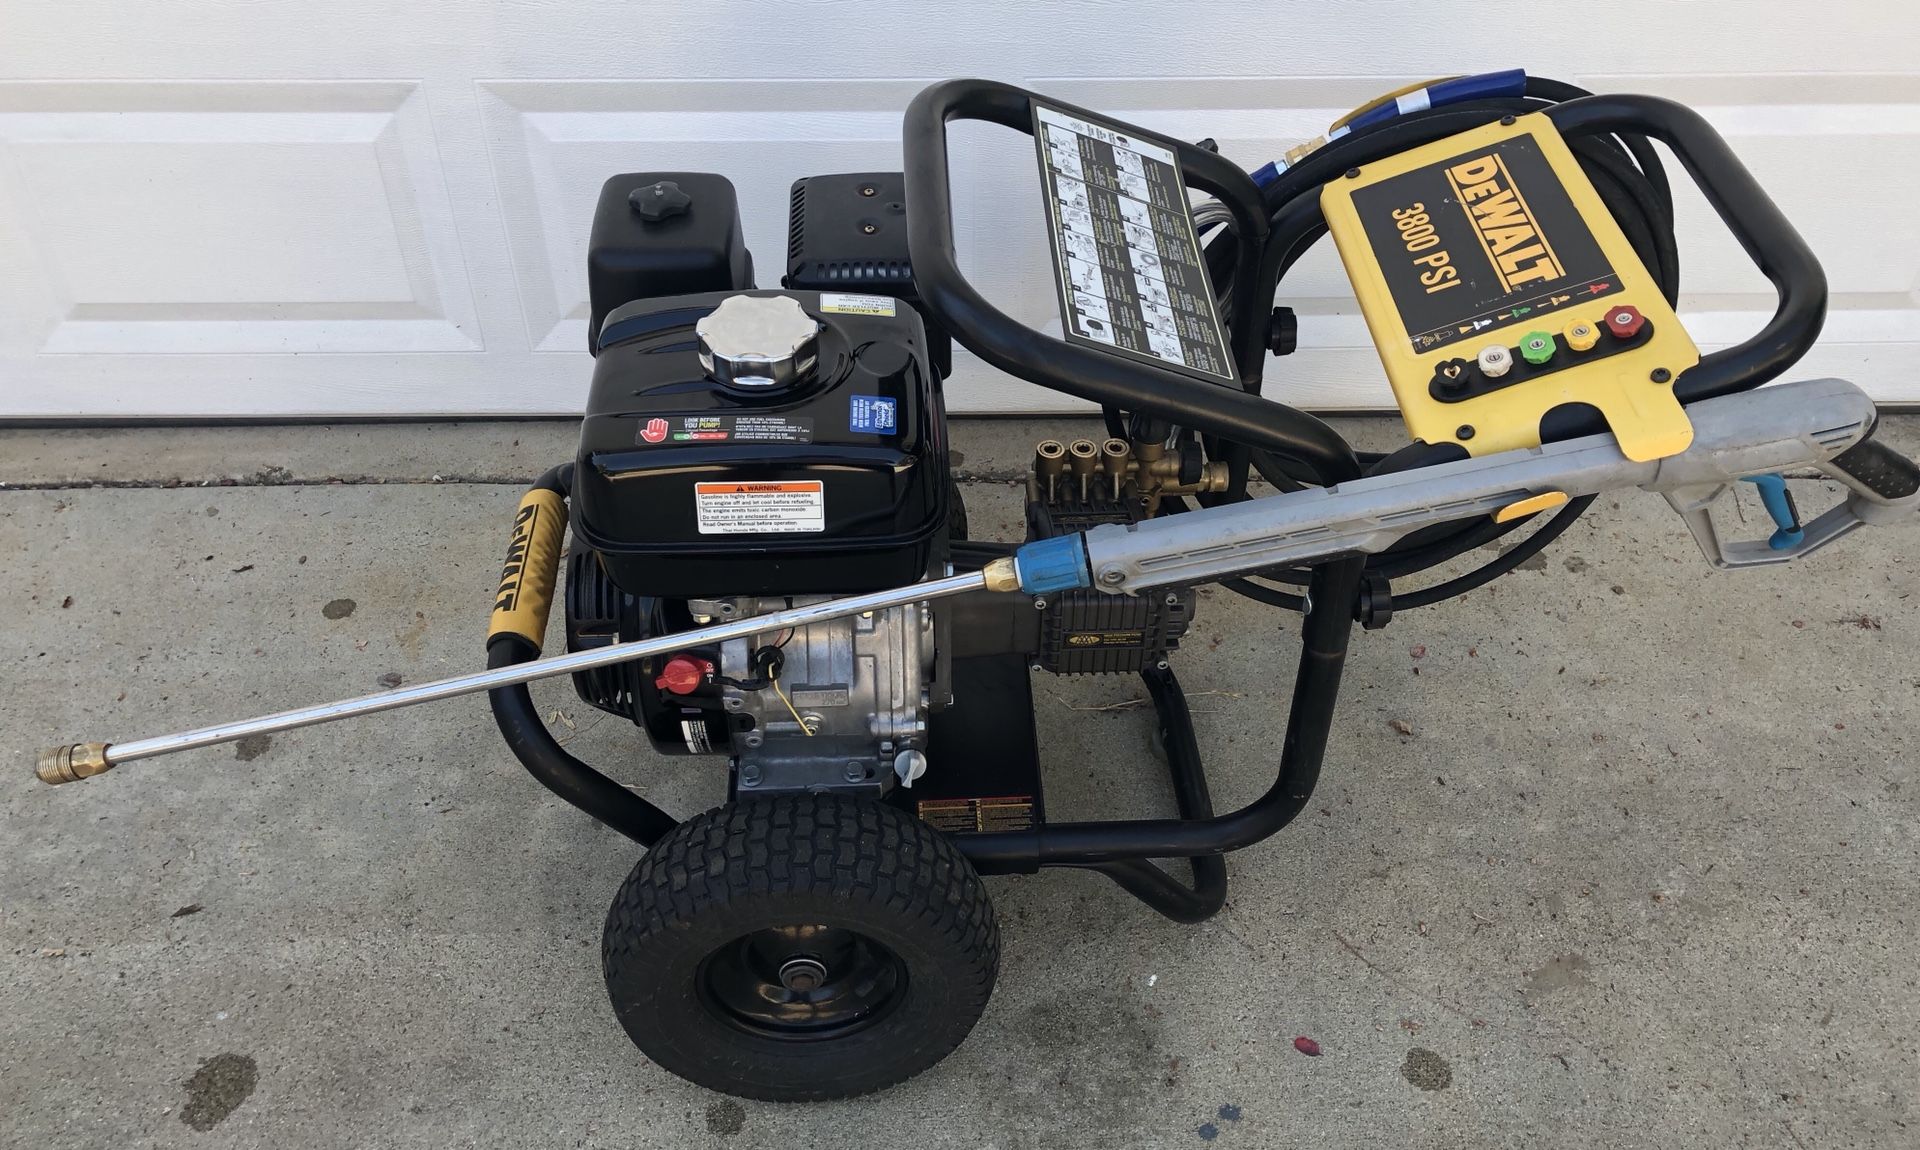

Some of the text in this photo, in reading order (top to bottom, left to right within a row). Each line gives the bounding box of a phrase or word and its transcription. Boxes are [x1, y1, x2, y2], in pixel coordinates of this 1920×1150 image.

[1392, 202, 1462, 294] 3800 PSI
[1450, 154, 1560, 287] DEWALT
